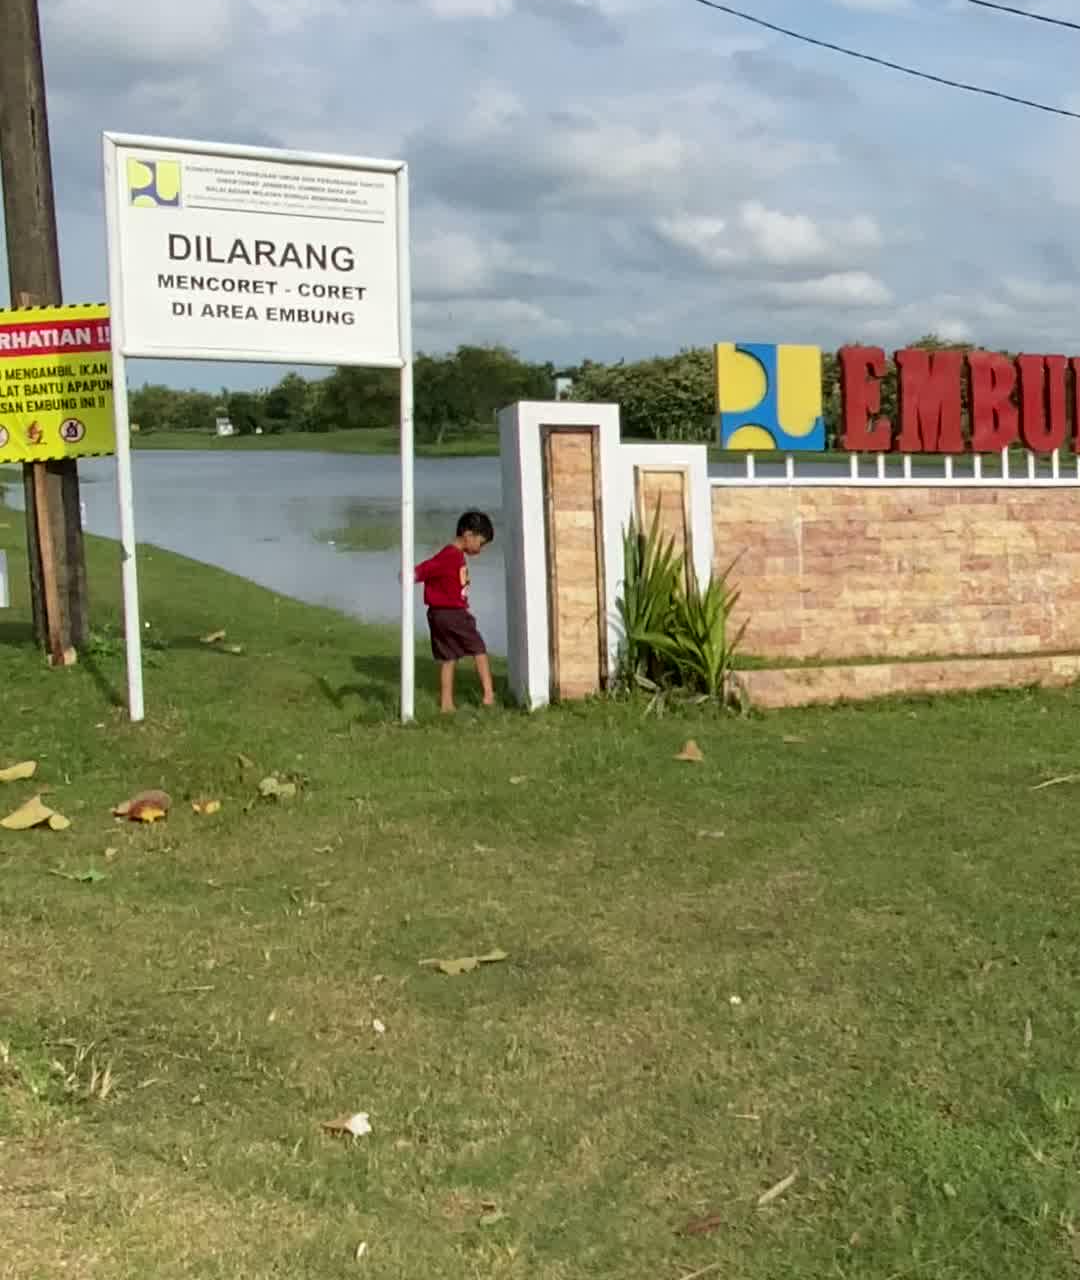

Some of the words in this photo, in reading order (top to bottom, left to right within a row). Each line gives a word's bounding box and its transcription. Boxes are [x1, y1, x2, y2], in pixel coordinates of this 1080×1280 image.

[168, 233, 355, 272] DILARANG
[157, 274, 278, 295] MENCORET
[298, 283, 367, 300] CORET
[172, 302, 193, 317] DI
[201, 304, 258, 321] AREA
[266, 307, 355, 325] EMBUNG
[5, 365, 76, 380] MENGAMBIL
[80, 363, 107, 376] IKAN
[24, 382, 63, 397] BANTU
[26, 399, 77, 413] EMBUNG
[80, 396, 95, 408] INI
